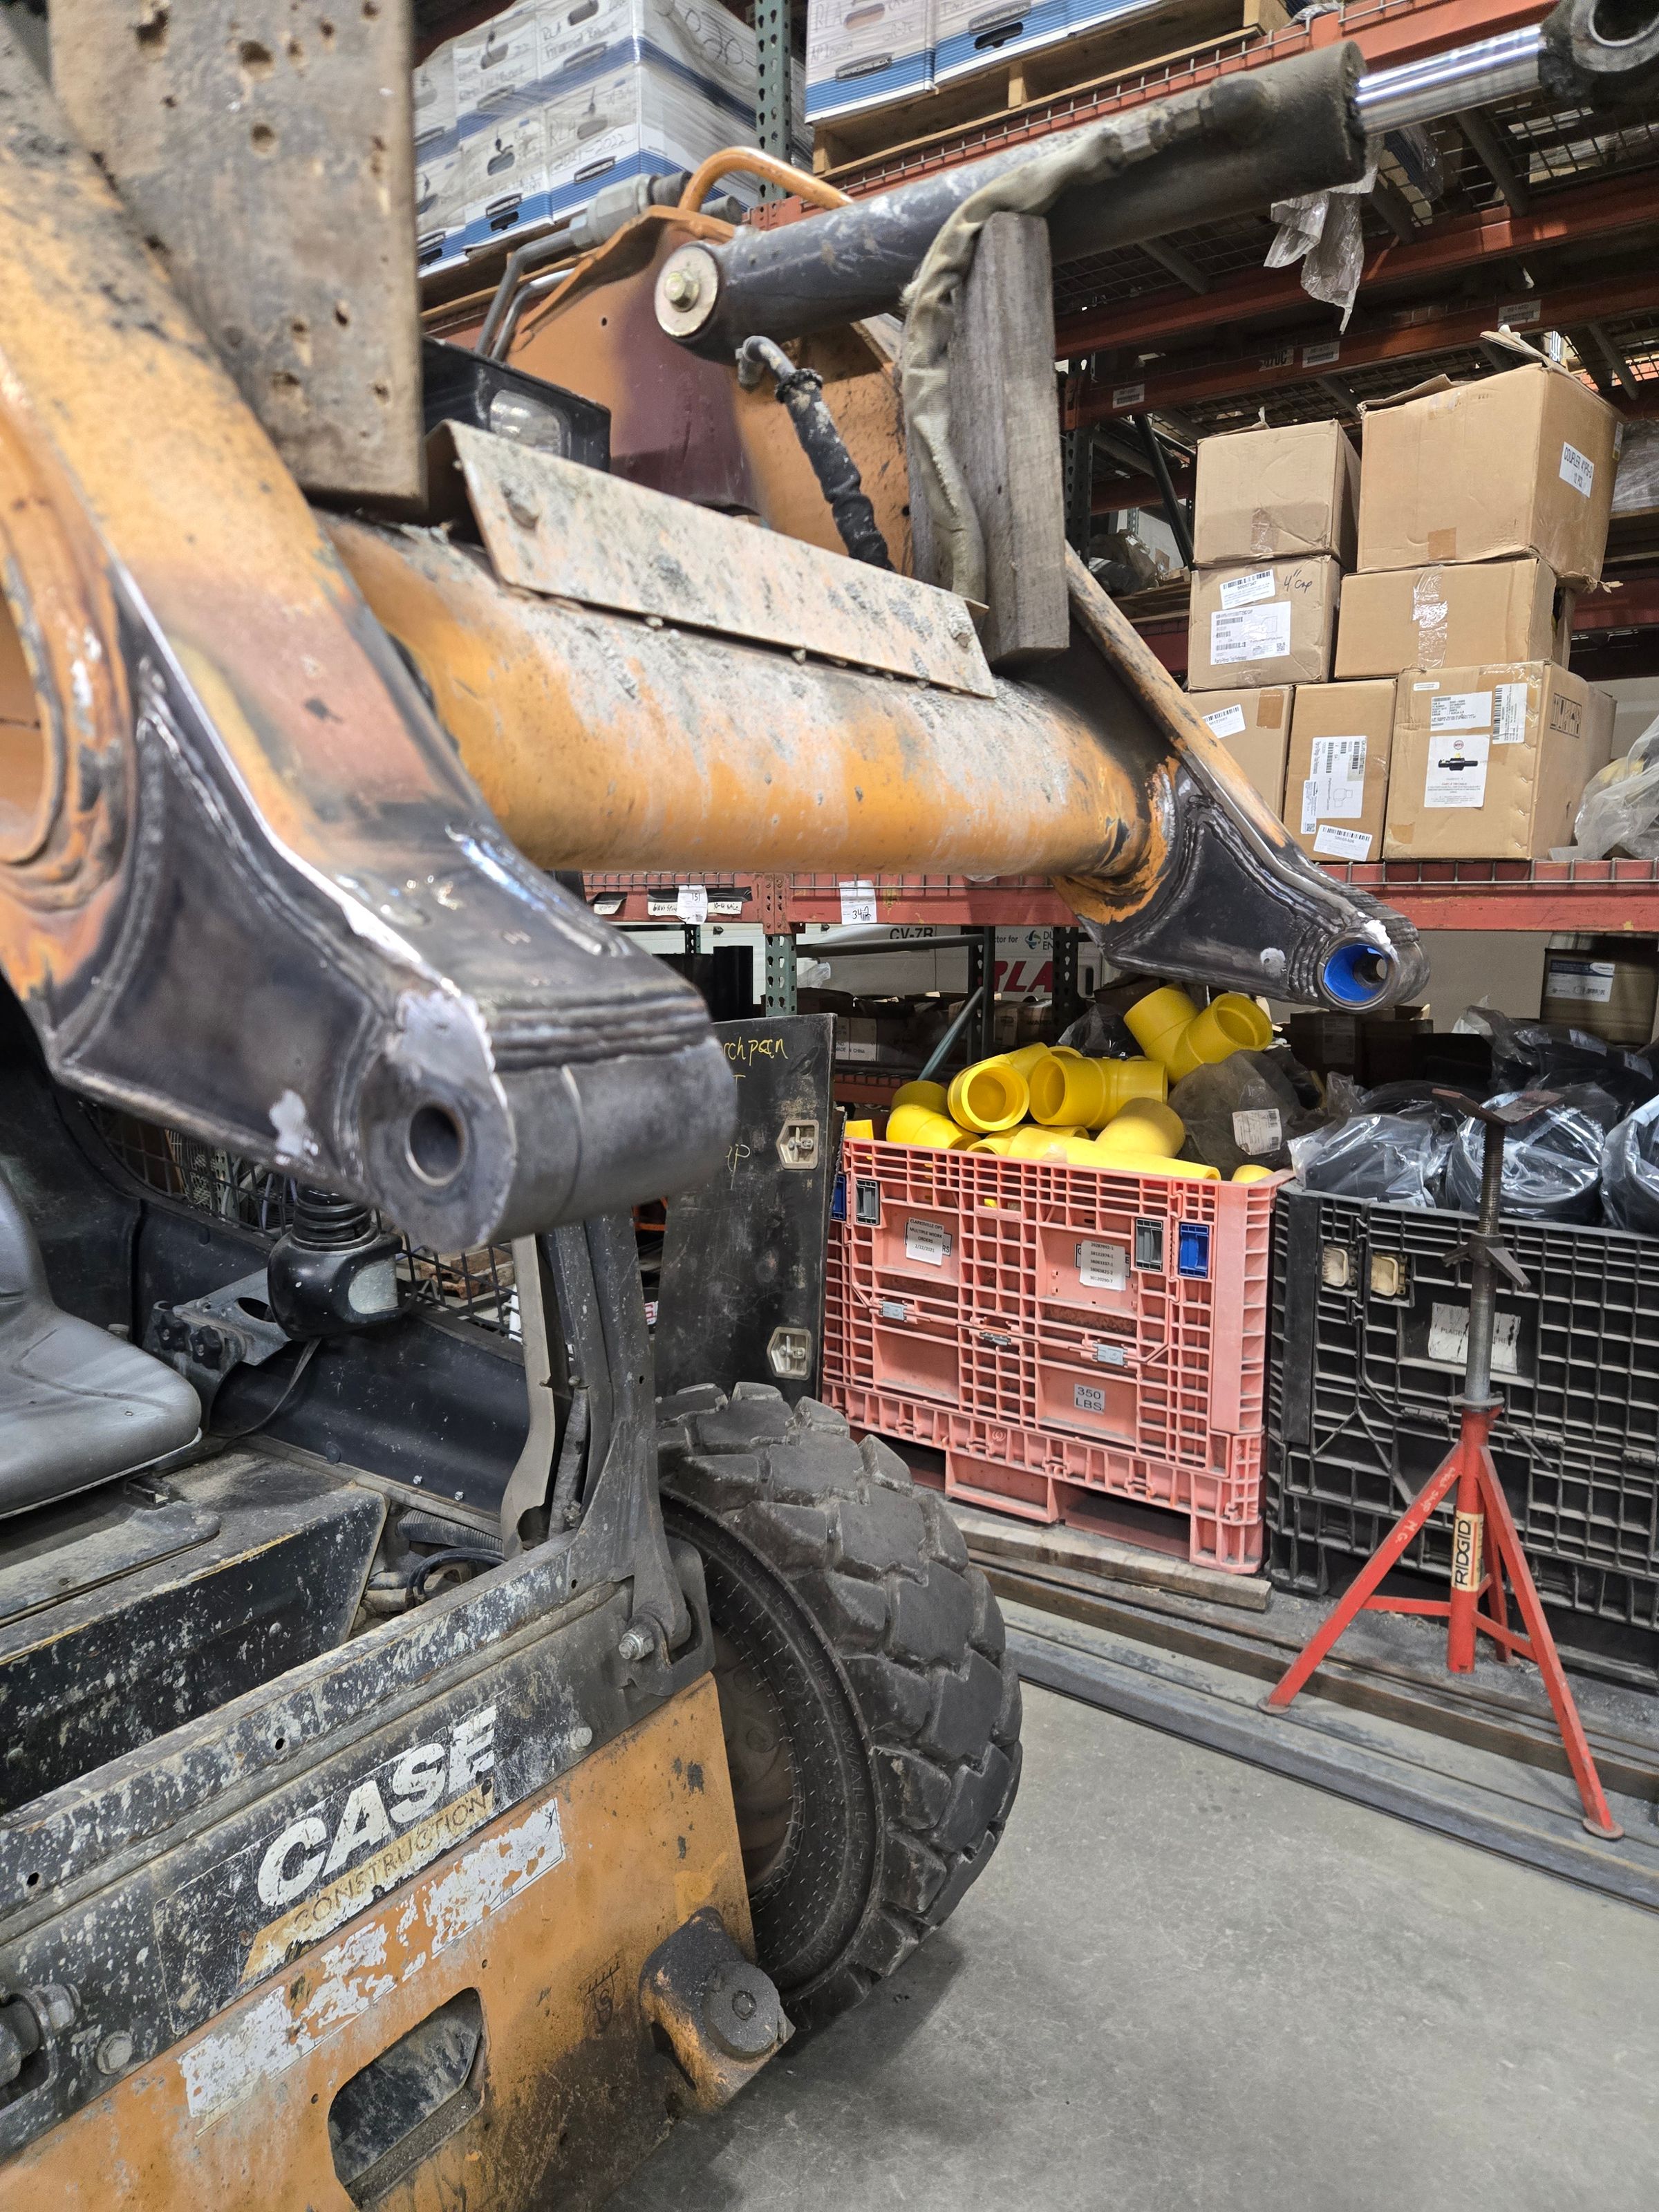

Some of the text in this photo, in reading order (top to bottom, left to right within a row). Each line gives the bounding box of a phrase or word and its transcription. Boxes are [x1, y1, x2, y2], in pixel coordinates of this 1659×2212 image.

[852, 906, 871, 919] 342
[1009, 935, 1018, 943] for
[1077, 1386, 1101, 1400] 350
[1455, 1519, 1472, 1586] RIDGID
[258, 1705, 496, 1906] CASE
[294, 1795, 486, 1931] CONSTRUCTION
